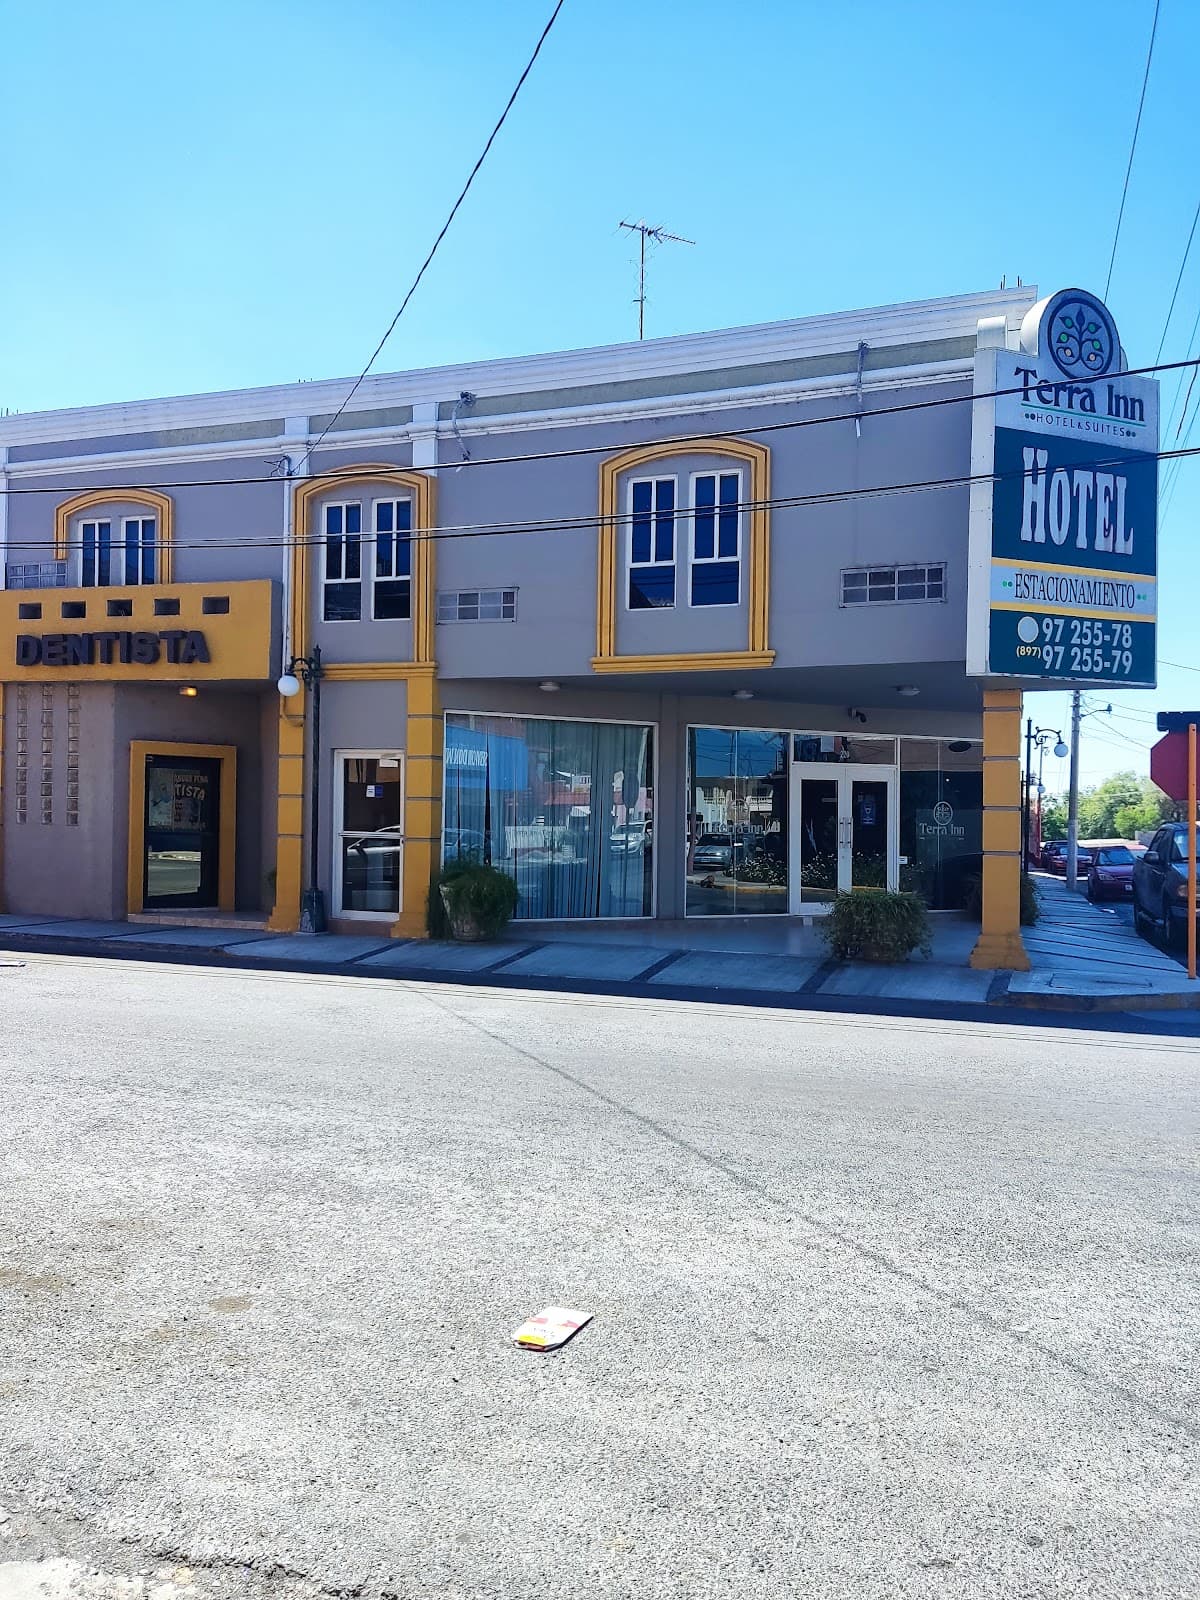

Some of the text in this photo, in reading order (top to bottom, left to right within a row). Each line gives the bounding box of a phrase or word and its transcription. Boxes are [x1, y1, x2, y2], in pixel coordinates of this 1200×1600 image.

[1014, 366, 1145, 421] Terra Inn
[1020, 446, 1134, 556] HOTEL
[1014, 573, 1135, 609] ESTACIONAMIENTO
[16, 630, 211, 666] DENTISTA
[1042, 617, 1132, 649] 97 255-78
[1016, 645, 1132, 674] (897) 97 255-79
[918, 823, 965, 836] Terra Inn
